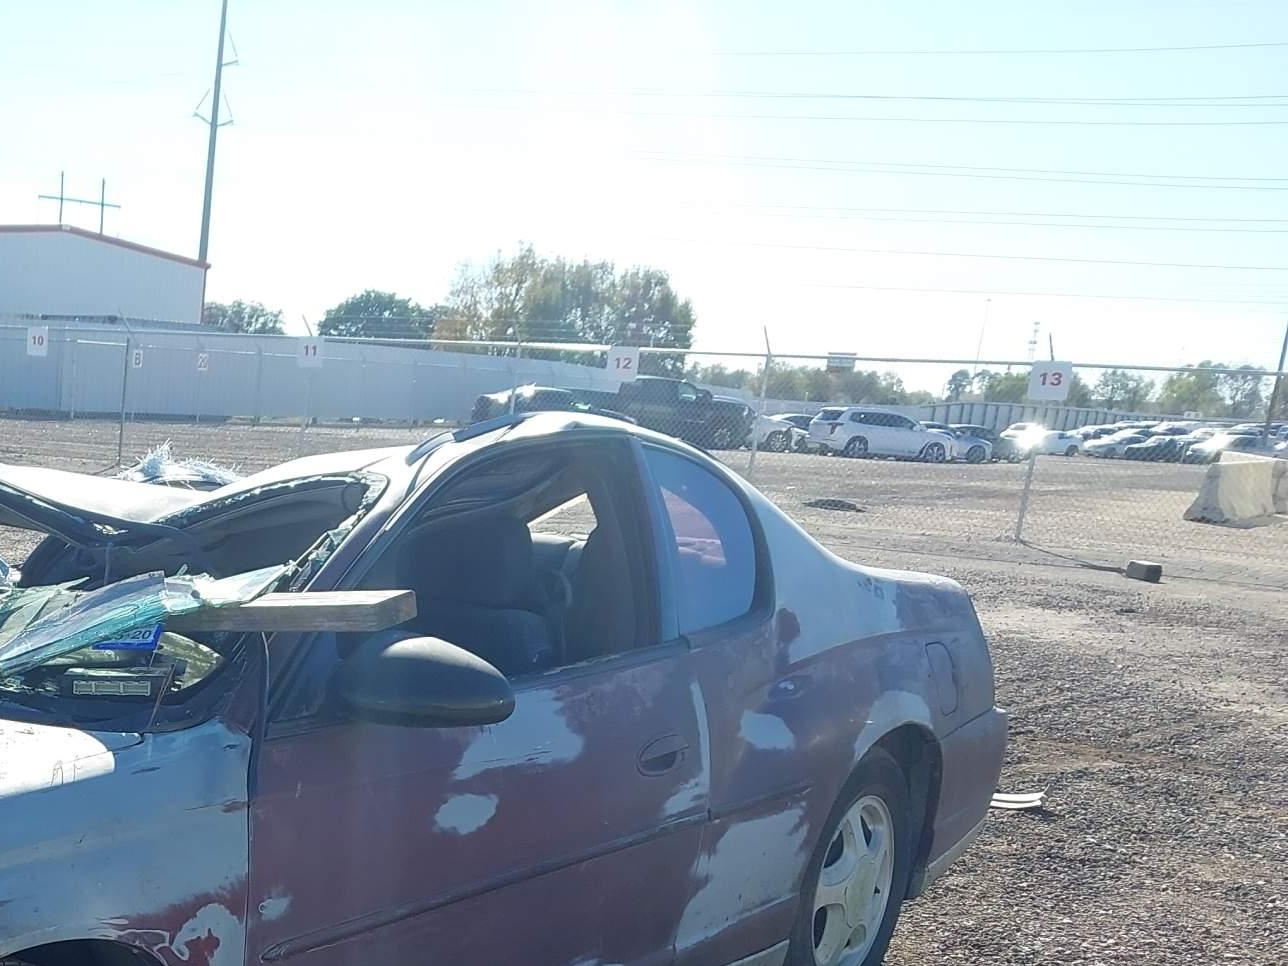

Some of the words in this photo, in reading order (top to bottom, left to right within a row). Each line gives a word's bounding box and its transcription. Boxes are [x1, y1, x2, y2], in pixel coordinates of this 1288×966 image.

[31, 335, 44, 346] 10
[303, 345, 317, 356] 11
[615, 356, 632, 369] 12
[1039, 372, 1063, 386] 13
